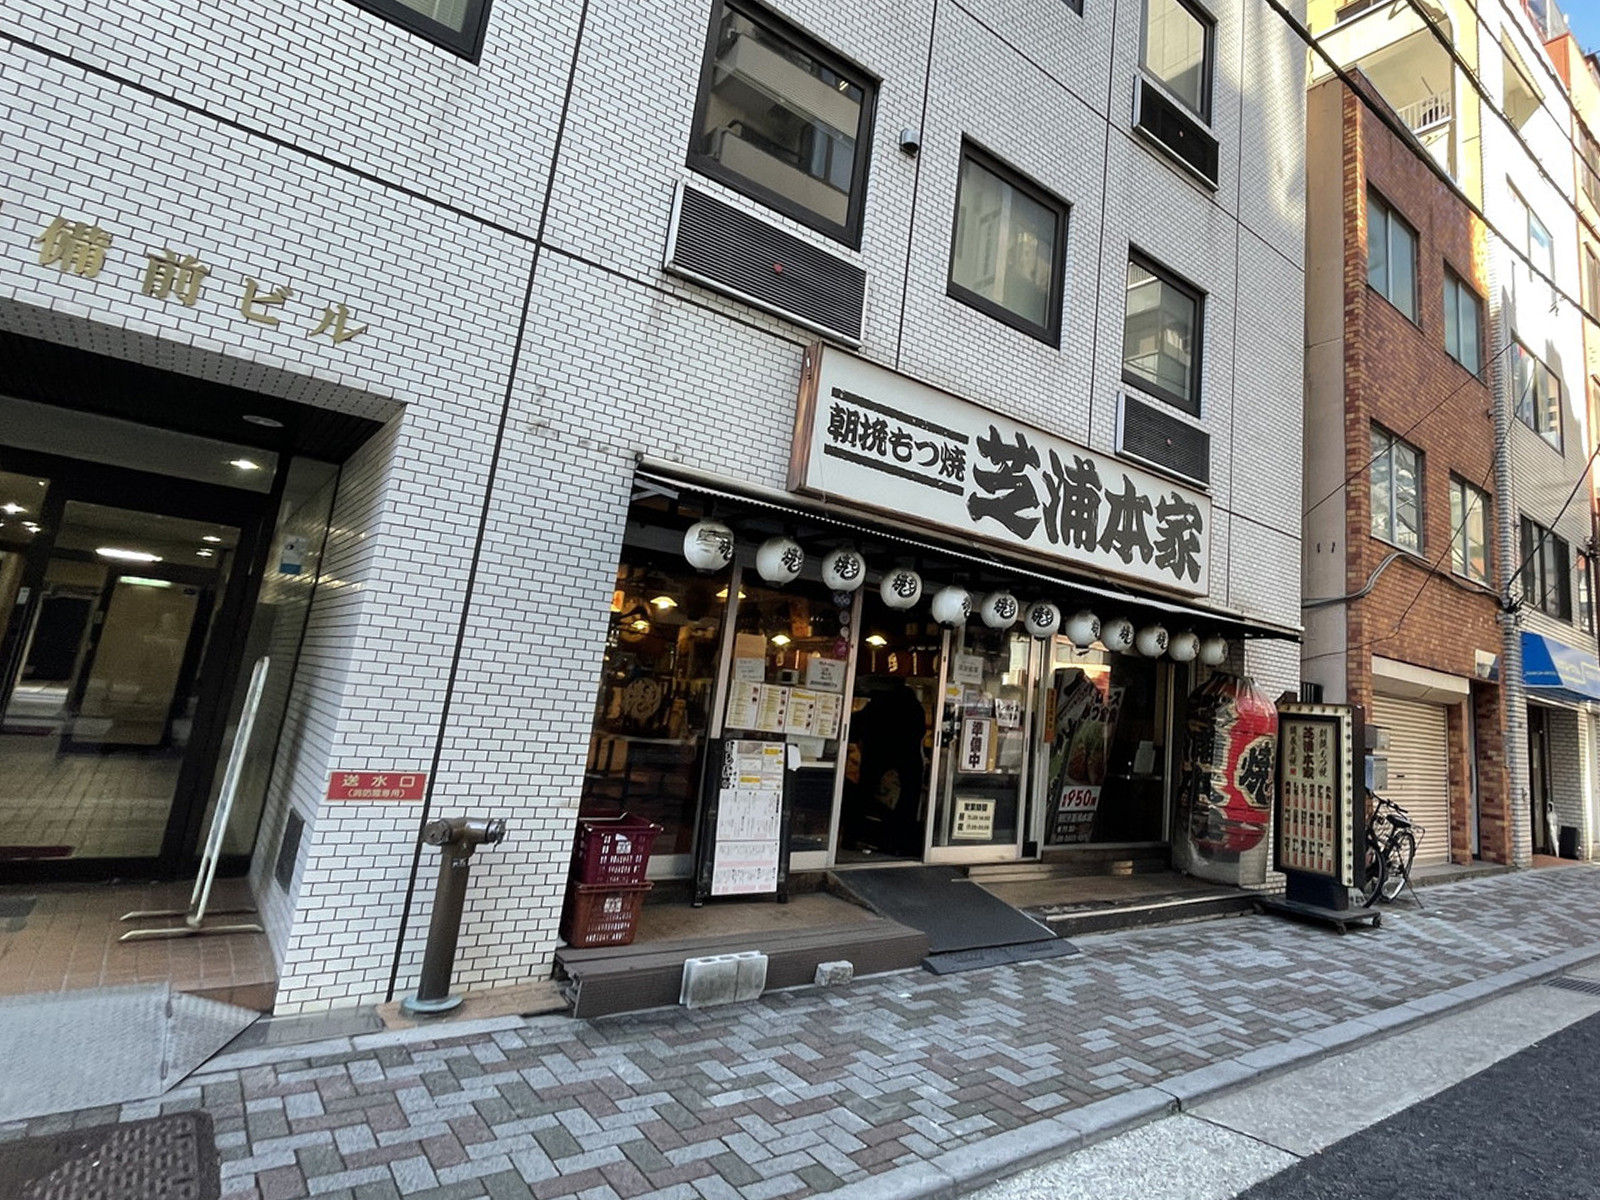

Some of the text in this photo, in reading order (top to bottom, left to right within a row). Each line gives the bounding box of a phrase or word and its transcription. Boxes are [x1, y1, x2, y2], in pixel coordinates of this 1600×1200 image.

[34, 215, 368, 344] 備前ビル
[967, 424, 1203, 584] 芝浦本家
[342, 774, 417, 788] 送水口
[968, 721, 984, 769] 準備中
